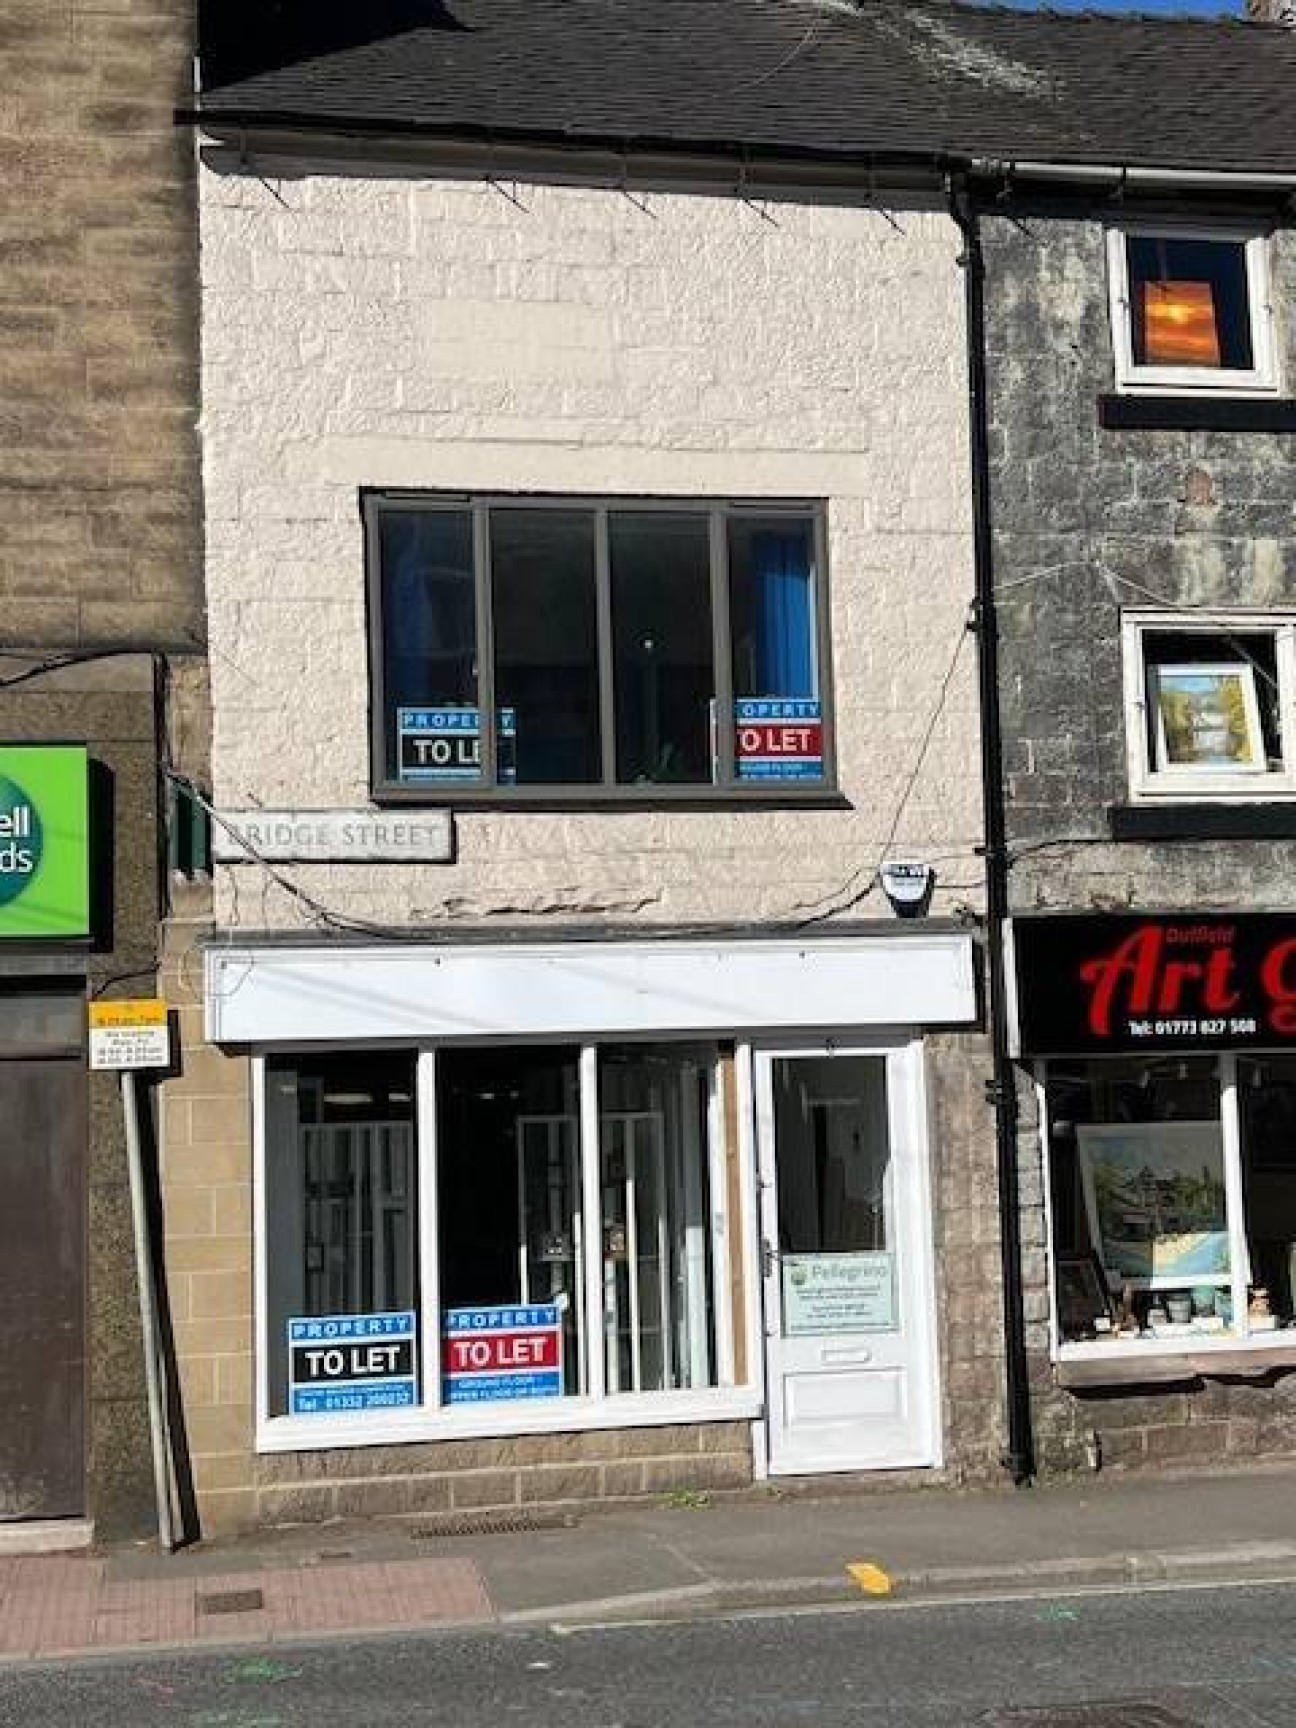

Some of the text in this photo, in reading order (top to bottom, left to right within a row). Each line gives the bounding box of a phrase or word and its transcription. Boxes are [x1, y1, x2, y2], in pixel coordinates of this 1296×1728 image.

[413, 739, 451, 764] TO
[766, 728, 811, 752] LET
[342, 823, 441, 846] STREET
[1080, 926, 1240, 1036] Art
[294, 1317, 408, 1338] PROPERTY
[305, 1344, 400, 1377] TO LET
[453, 1336, 549, 1367] TO LET
